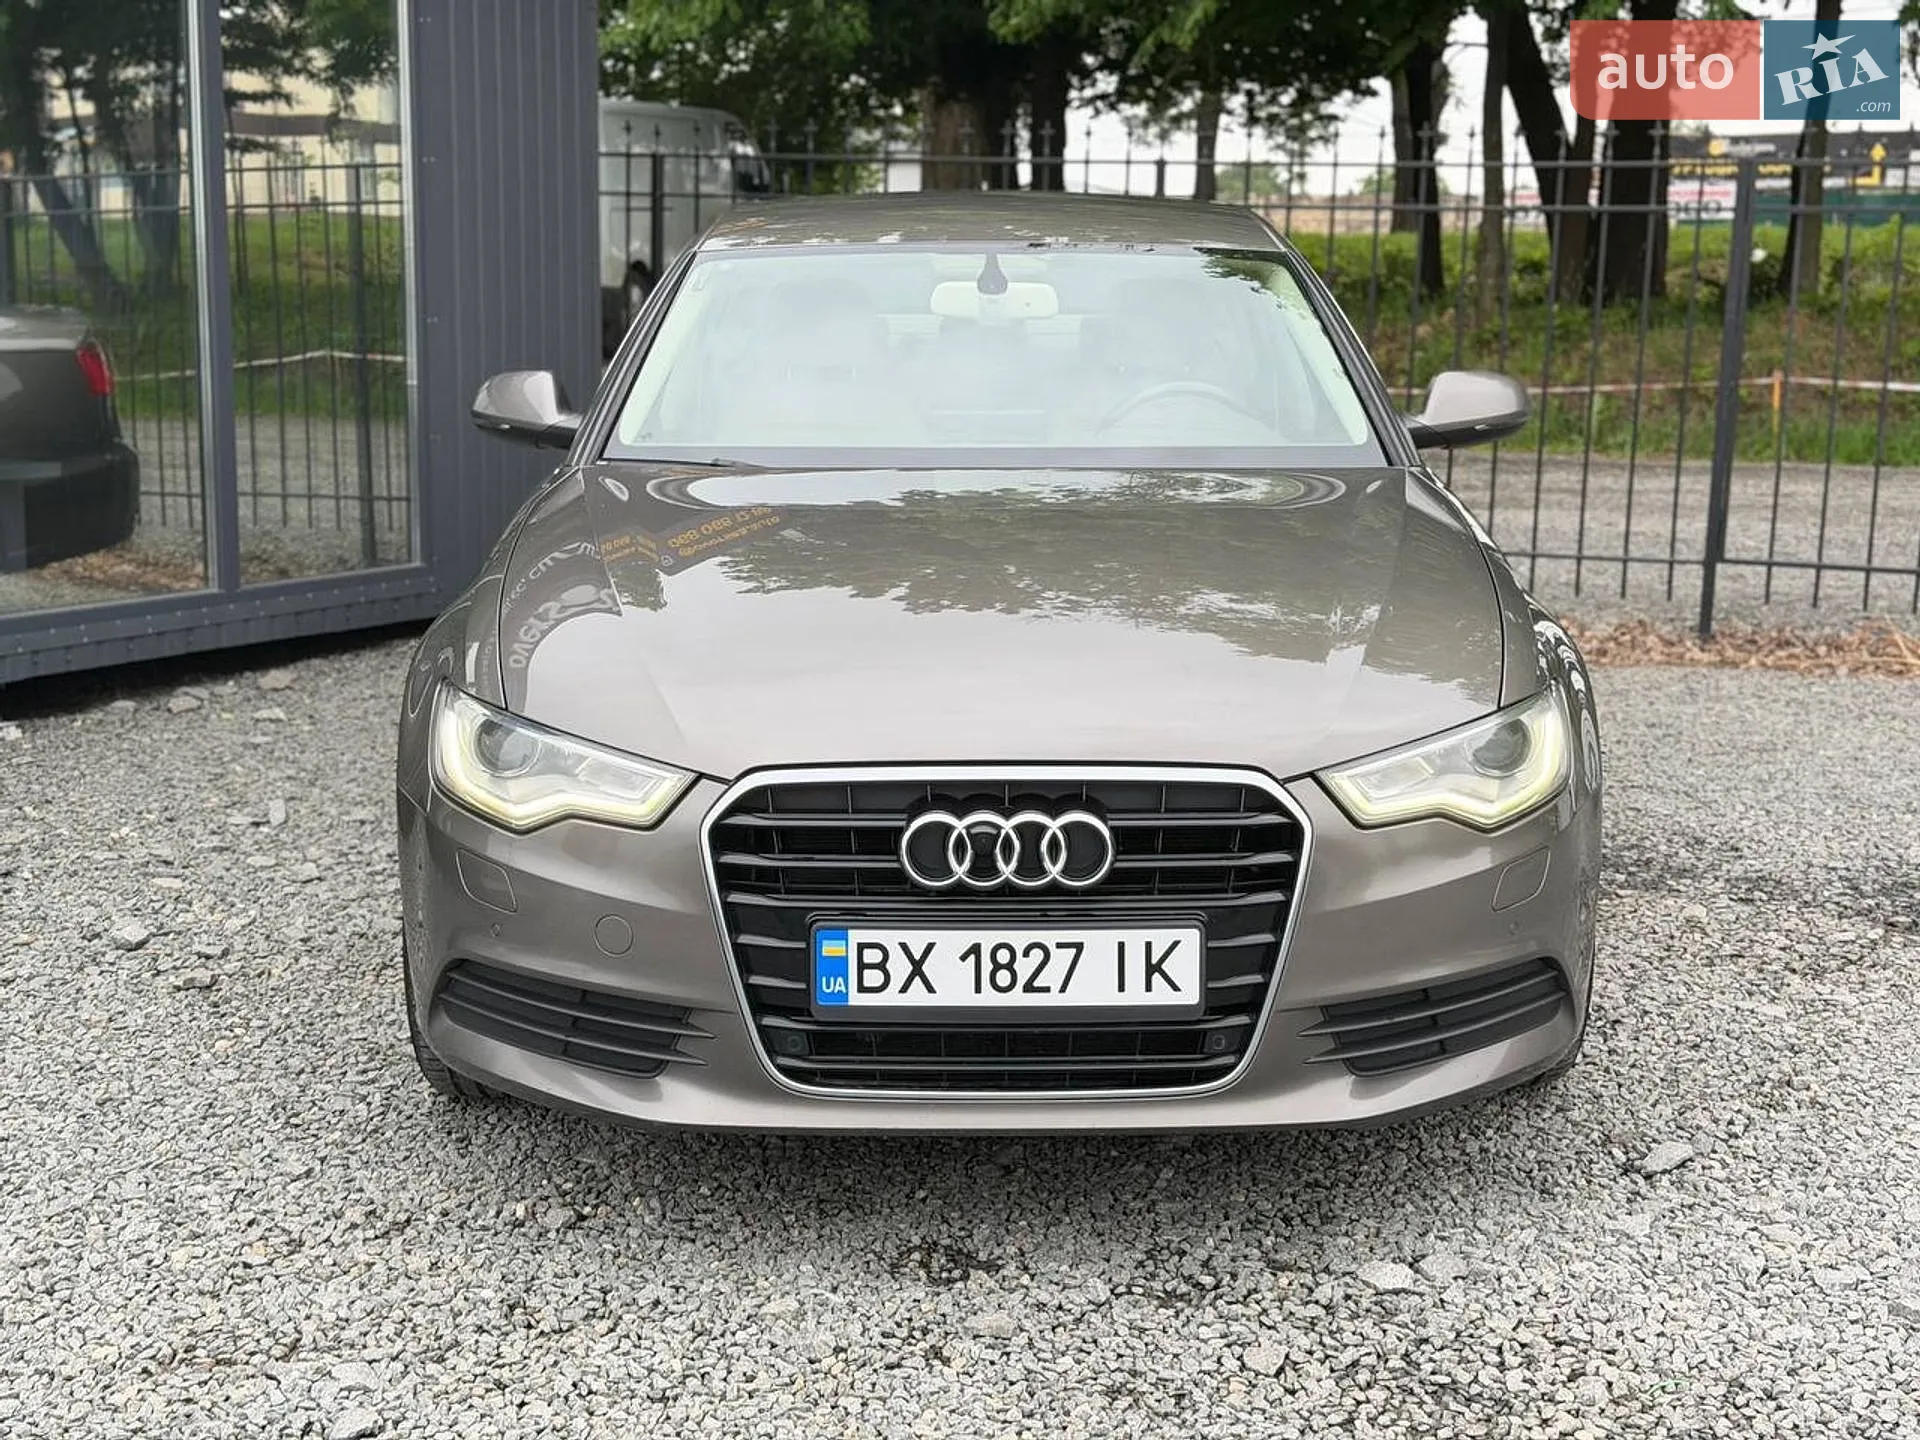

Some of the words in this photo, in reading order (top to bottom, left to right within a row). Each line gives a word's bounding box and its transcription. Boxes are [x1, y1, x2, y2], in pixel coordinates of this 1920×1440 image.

[822, 975, 846, 993] UA
[856, 941, 937, 994] BX
[958, 941, 1085, 994] 1827
[1117, 939, 1182, 994] IK
